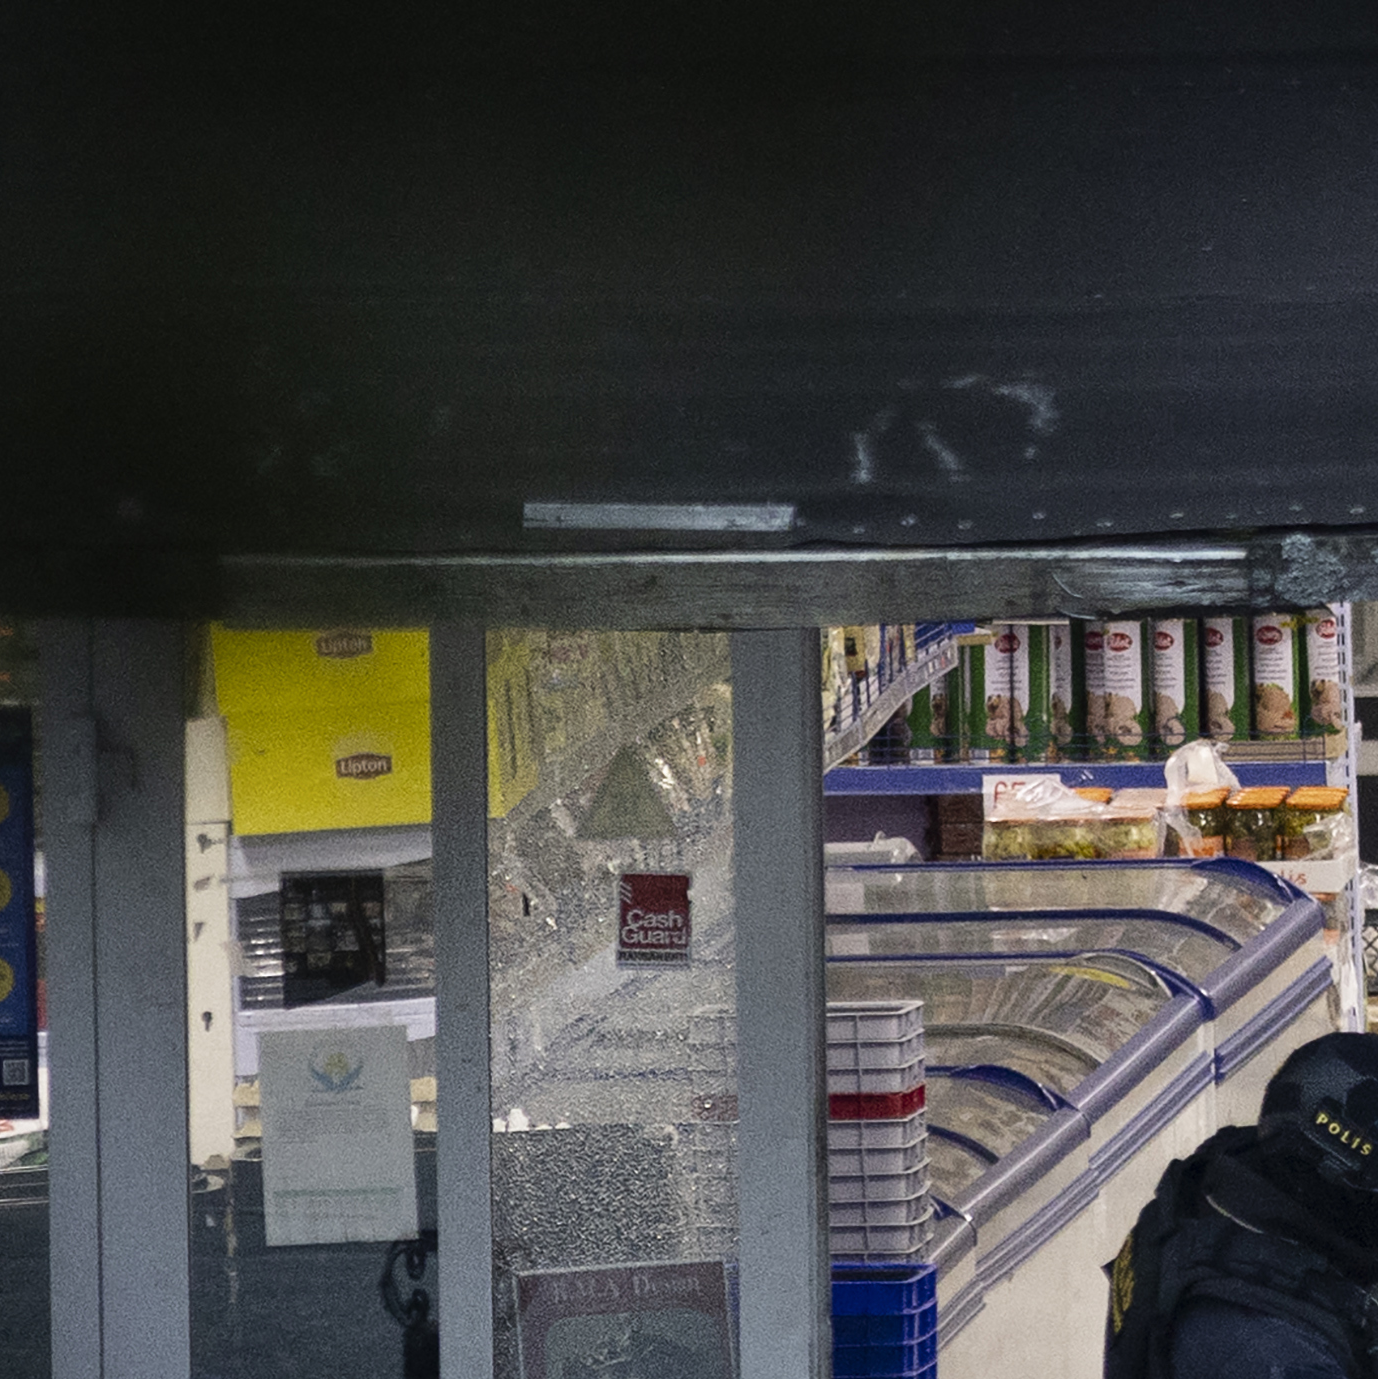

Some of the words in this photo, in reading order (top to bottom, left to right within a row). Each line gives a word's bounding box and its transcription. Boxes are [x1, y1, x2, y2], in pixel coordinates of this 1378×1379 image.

[340, 758, 388, 775] Lipton
[627, 909, 683, 928] Cash
[622, 926, 687, 944] Guard
[1316, 1112, 1373, 1156] POLIS
